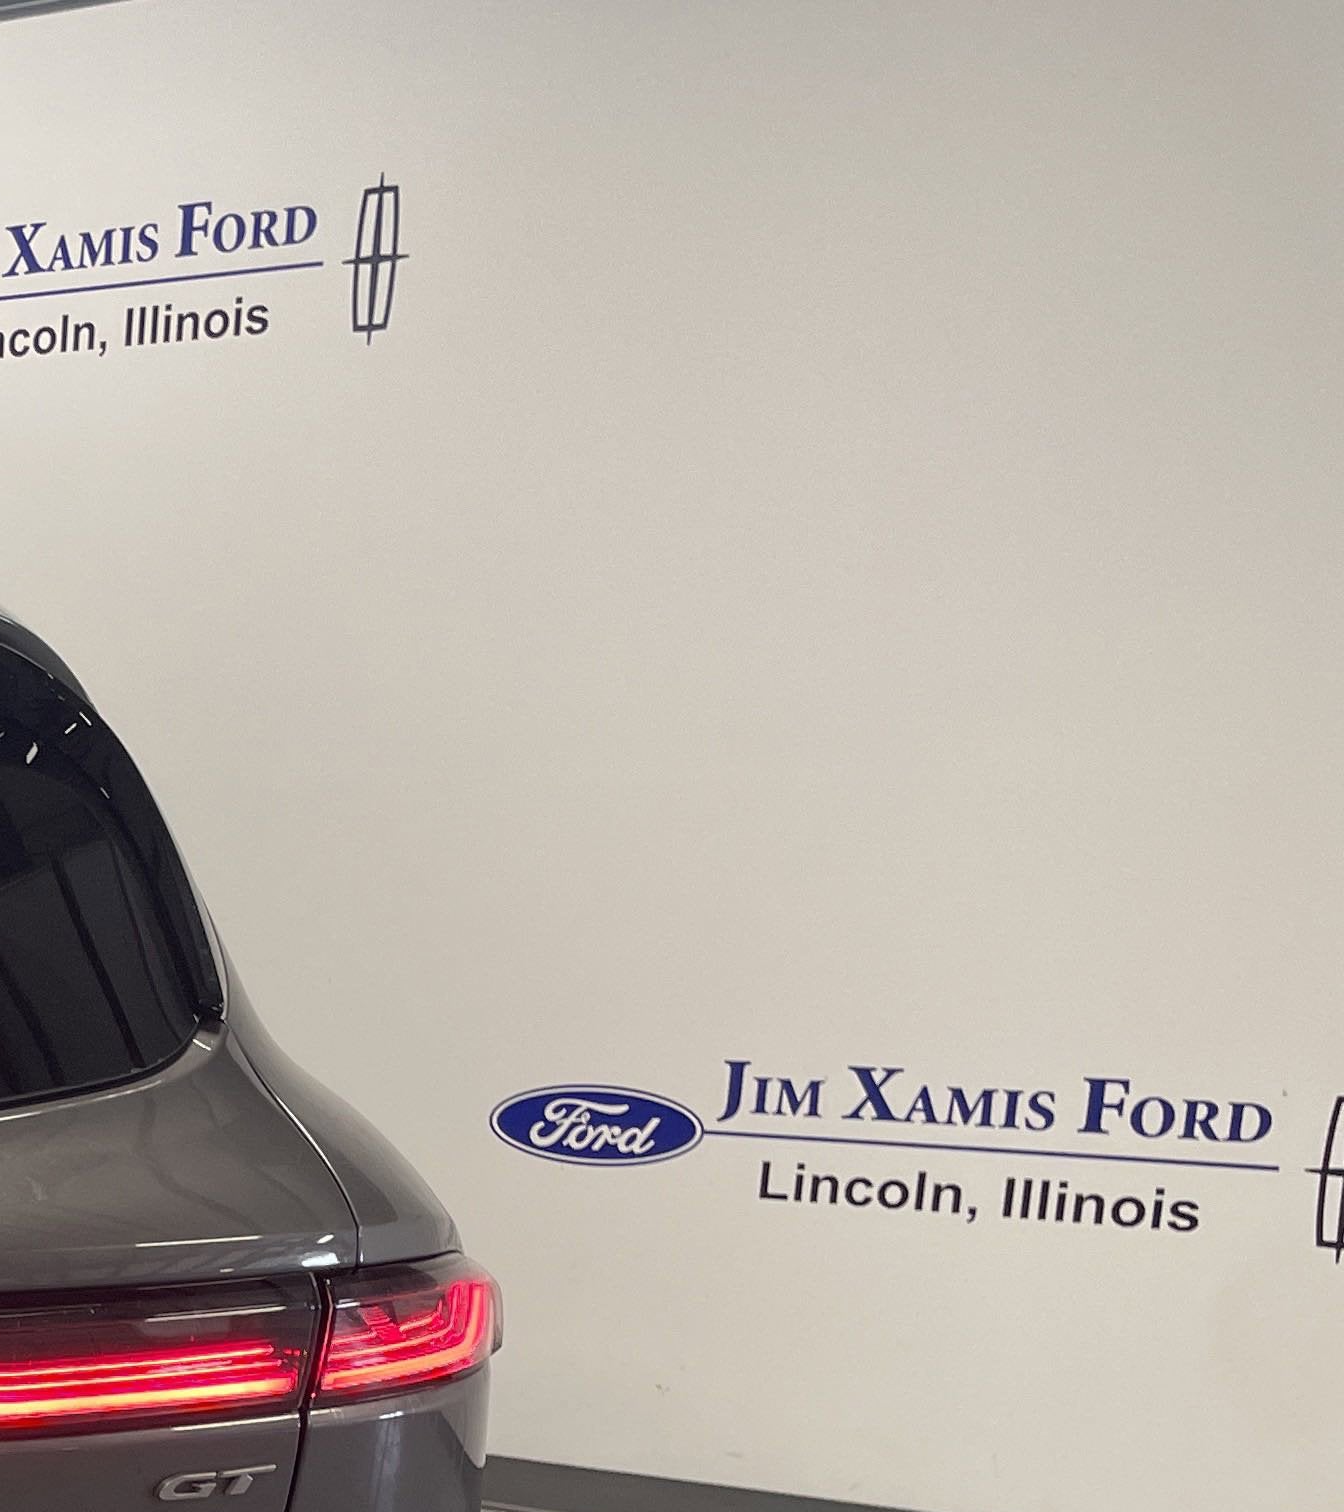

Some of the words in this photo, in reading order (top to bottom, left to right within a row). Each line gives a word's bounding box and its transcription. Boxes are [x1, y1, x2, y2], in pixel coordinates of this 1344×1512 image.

[3, 221, 159, 278] XAMIS
[174, 201, 317, 258] FORD
[124, 297, 269, 348] Illinois
[529, 1097, 656, 1158] Ford
[717, 1059, 825, 1122] JIM
[842, 1065, 1055, 1132] XAMIS
[1077, 1076, 1272, 1144] FORD
[758, 1161, 979, 1225] Lincoln,
[1001, 1178, 1200, 1233] Illinois
[157, 1464, 277, 1500] GT
